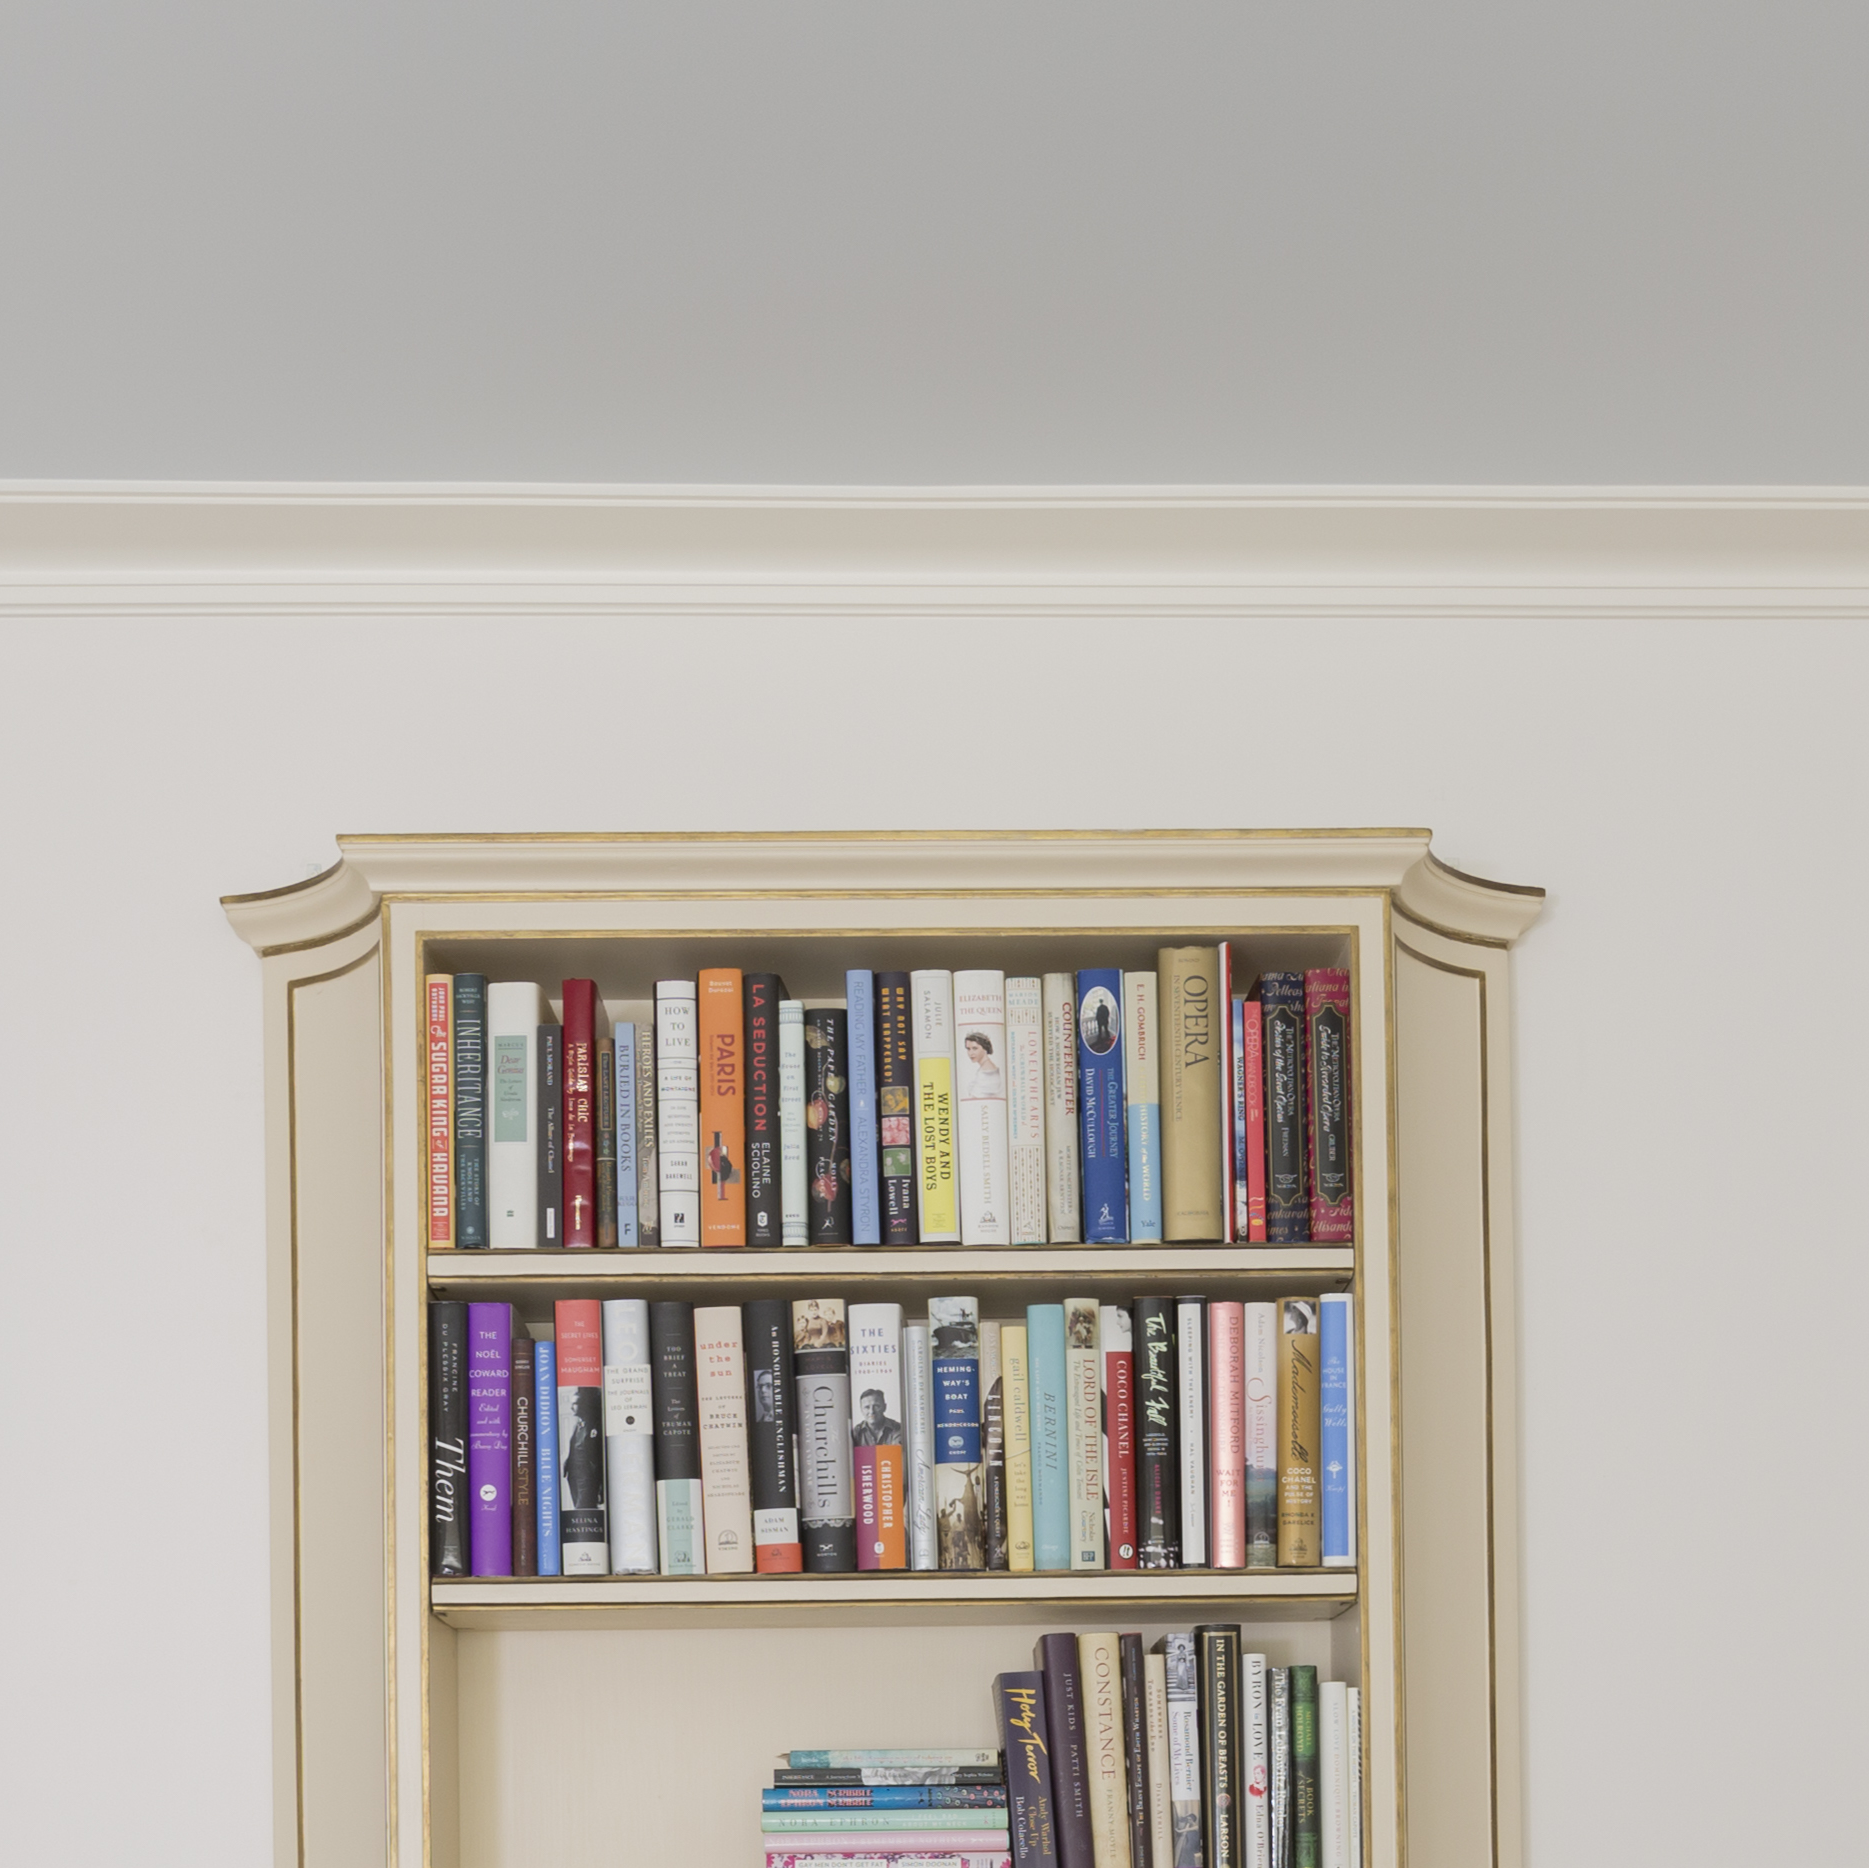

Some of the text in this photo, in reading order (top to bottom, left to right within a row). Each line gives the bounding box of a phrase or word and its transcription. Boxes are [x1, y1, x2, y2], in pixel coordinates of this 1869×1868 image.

[664, 1007, 690, 1015] HOW
[669, 1022, 685, 1031] TO
[1137, 994, 1145, 1004] H.
[1137, 1007, 1146, 1060] GOMBRICH
[1184, 975, 1210, 1068] OPERA
[431, 1042, 447, 1095] SUGAR
[456, 1019, 482, 1139] INHERITANCE
[664, 1038, 691, 1047] LIVE
[716, 1034, 736, 1096] PARIS
[752, 984, 767, 1131] LA SEDUCTION
[1062, 1002, 1075, 1116] COUNTERFEITER
[431, 1099, 447, 1136] KING
[618, 1045, 632, 1172] BURIED IN BOOKS
[923, 1082, 937, 1191] THE LOST BOYS
[937, 1093, 951, 1180] WENDY AND
[432, 1152, 448, 1217] HAVANA
[751, 1142, 761, 1198] SCIOLINO
[761, 1142, 771, 1184] ELAINE
[468, 1370, 509, 1378] COWARD
[471, 1389, 507, 1397] READER
[772, 1341, 784, 1415] HONOURABLE
[1010, 1358, 1027, 1441] gail caldwell
[1117, 1360, 1129, 1458] COCO CHANEL
[1229, 1316, 1240, 1454] DEBORAH MITFORD
[539, 1347, 553, 1537] JOAN DIDION BLUE NIGHTS
[775, 1420, 787, 1493] ENGLISHMAN
[812, 1386, 836, 1508] Churchills
[1083, 1359, 1099, 1501] LORD OF THE ISLE
[434, 1437, 466, 1523] Them
[862, 1465, 873, 1525] ISHERWOOD
[881, 1460, 893, 1528] CHRISTOPHER
[1063, 1673, 1083, 1818] JUST KIDS PATTI SMITH
[1094, 1647, 1115, 1780] CONSTANCE
[1216, 1639, 1229, 1858] IN THE GARDEN OF BEASTS LARSON
[798, 1860, 813, 1868] GAY
[814, 1860, 830, 1868] MEN
[856, 1860, 868, 1868] GET
[869, 1860, 883, 1868] FAT
[901, 1860, 958, 1868] SIMON DOONAN
